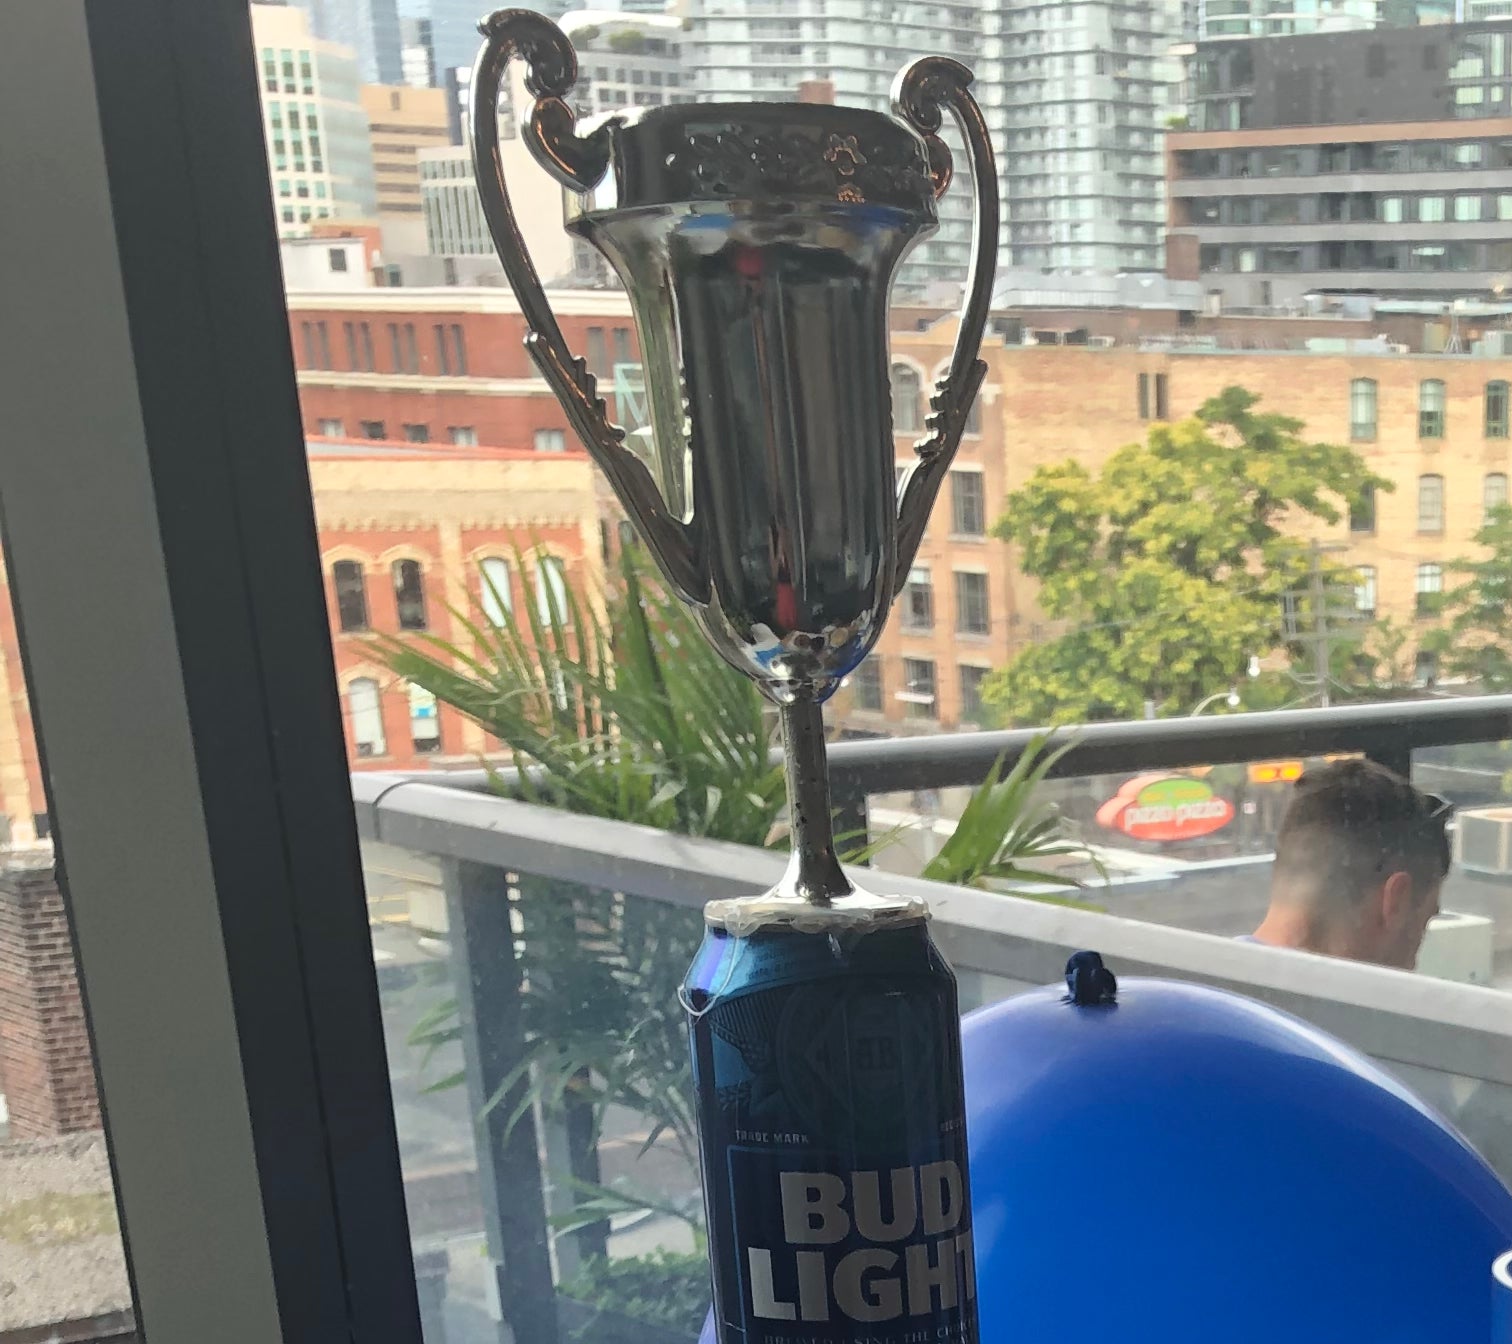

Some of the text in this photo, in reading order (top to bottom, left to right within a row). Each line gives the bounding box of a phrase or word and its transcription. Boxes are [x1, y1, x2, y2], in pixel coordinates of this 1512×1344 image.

[773, 1131, 810, 1145] MARK
[779, 1159, 963, 1244] BUD
[748, 1228, 976, 1322] LIGHT
